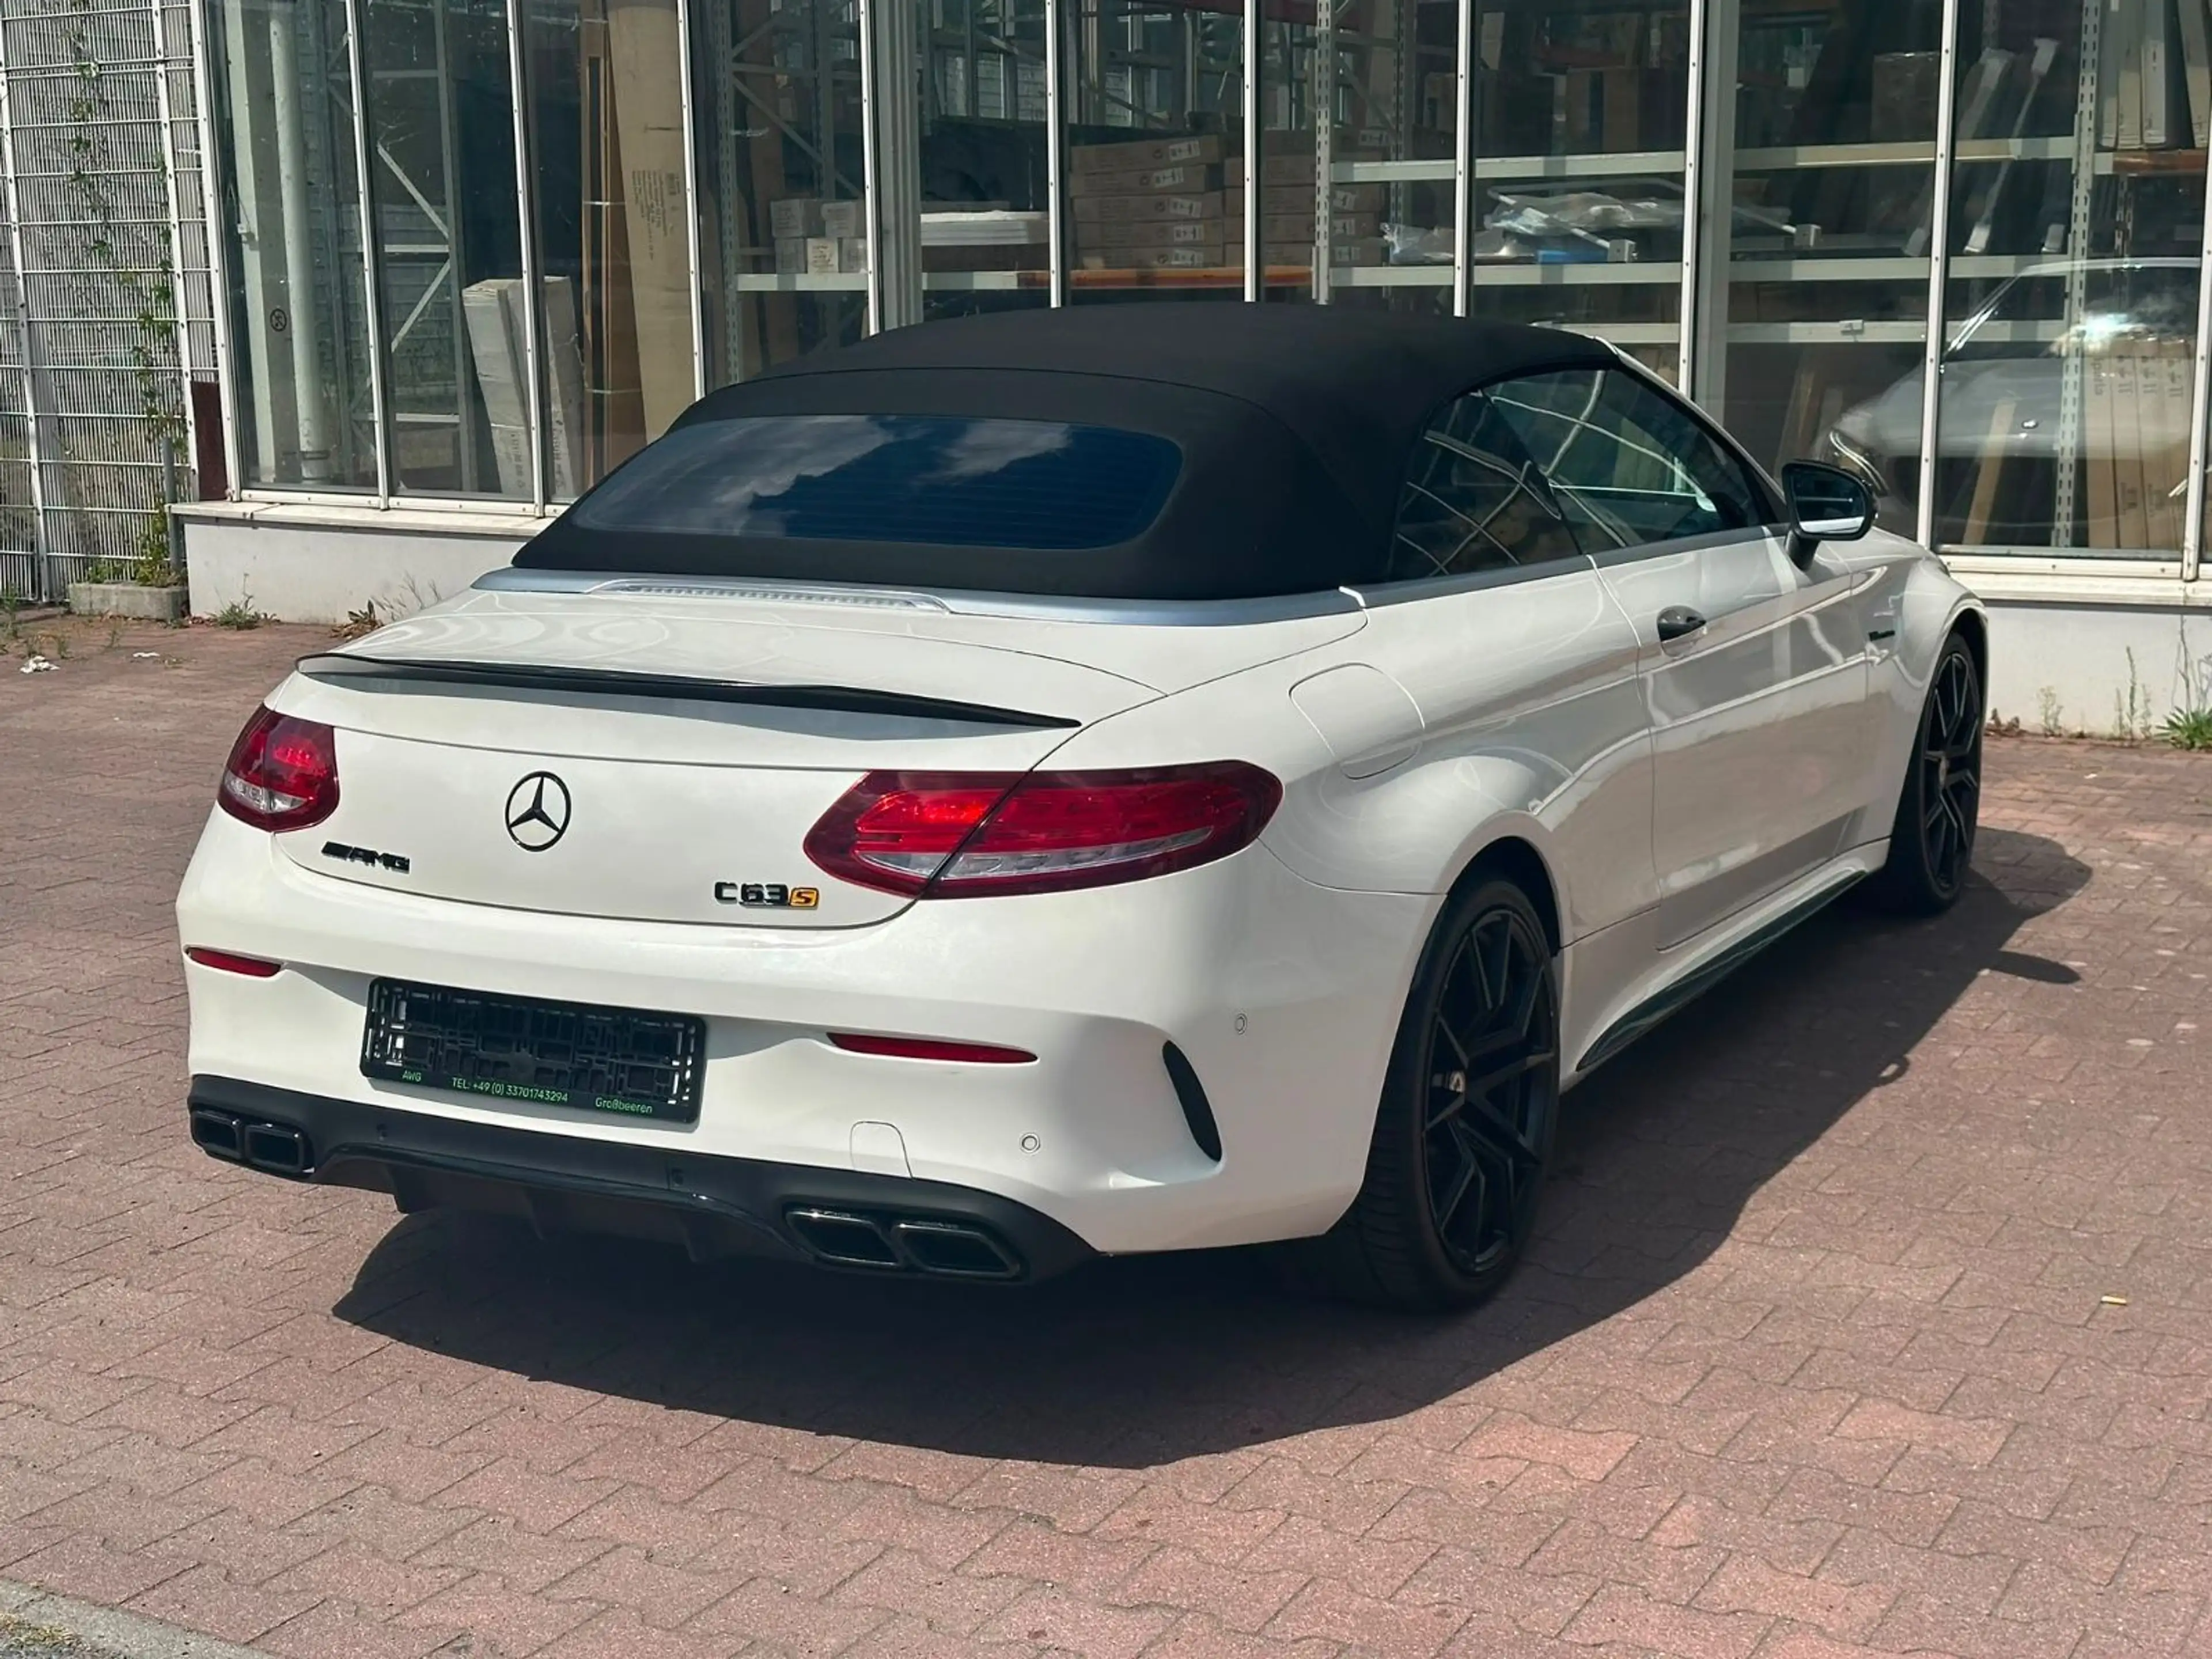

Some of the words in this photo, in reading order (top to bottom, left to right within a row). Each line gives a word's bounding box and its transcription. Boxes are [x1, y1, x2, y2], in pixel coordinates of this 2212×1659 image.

[346, 846, 410, 874] AMG
[402, 1069, 422, 1082] AWG
[473, 1082, 490, 1092] +49
[491, 1082, 505, 1096] (0)
[506, 1084, 569, 1103] 33701743294
[595, 1097, 653, 1113] Großbeeren
